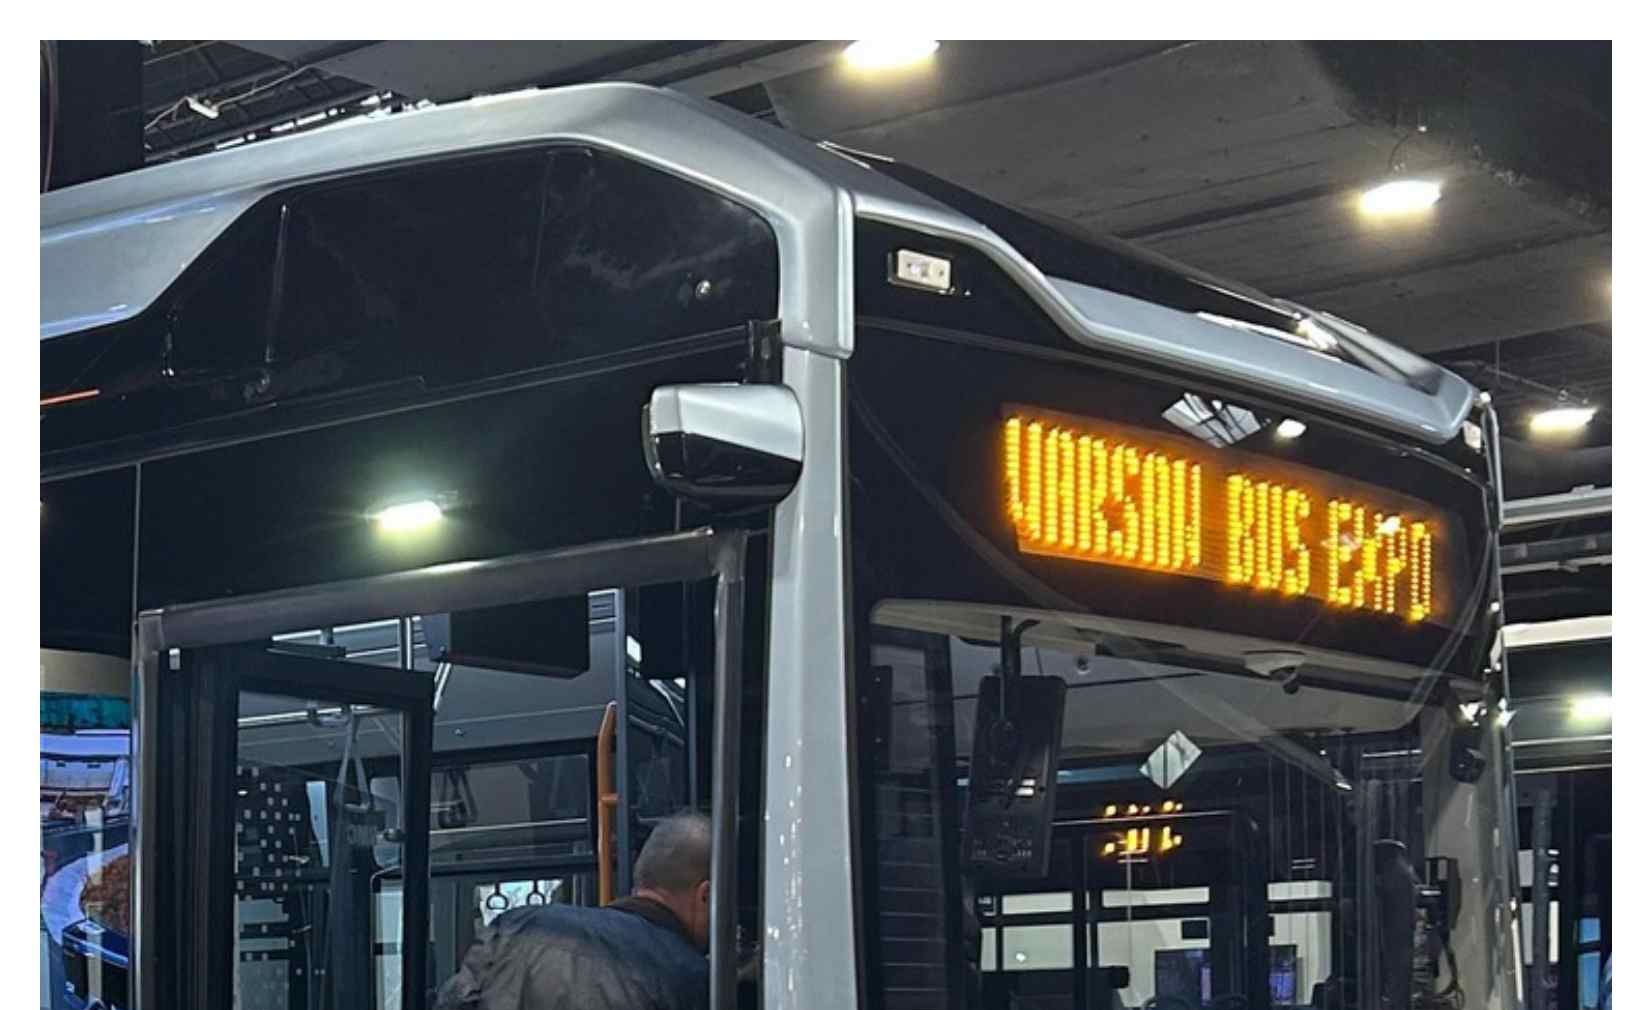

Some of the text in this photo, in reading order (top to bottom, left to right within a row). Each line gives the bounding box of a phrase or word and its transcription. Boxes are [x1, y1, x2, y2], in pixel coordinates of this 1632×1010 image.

[1004, 416, 1433, 623] WARSAW BUS EXPO
